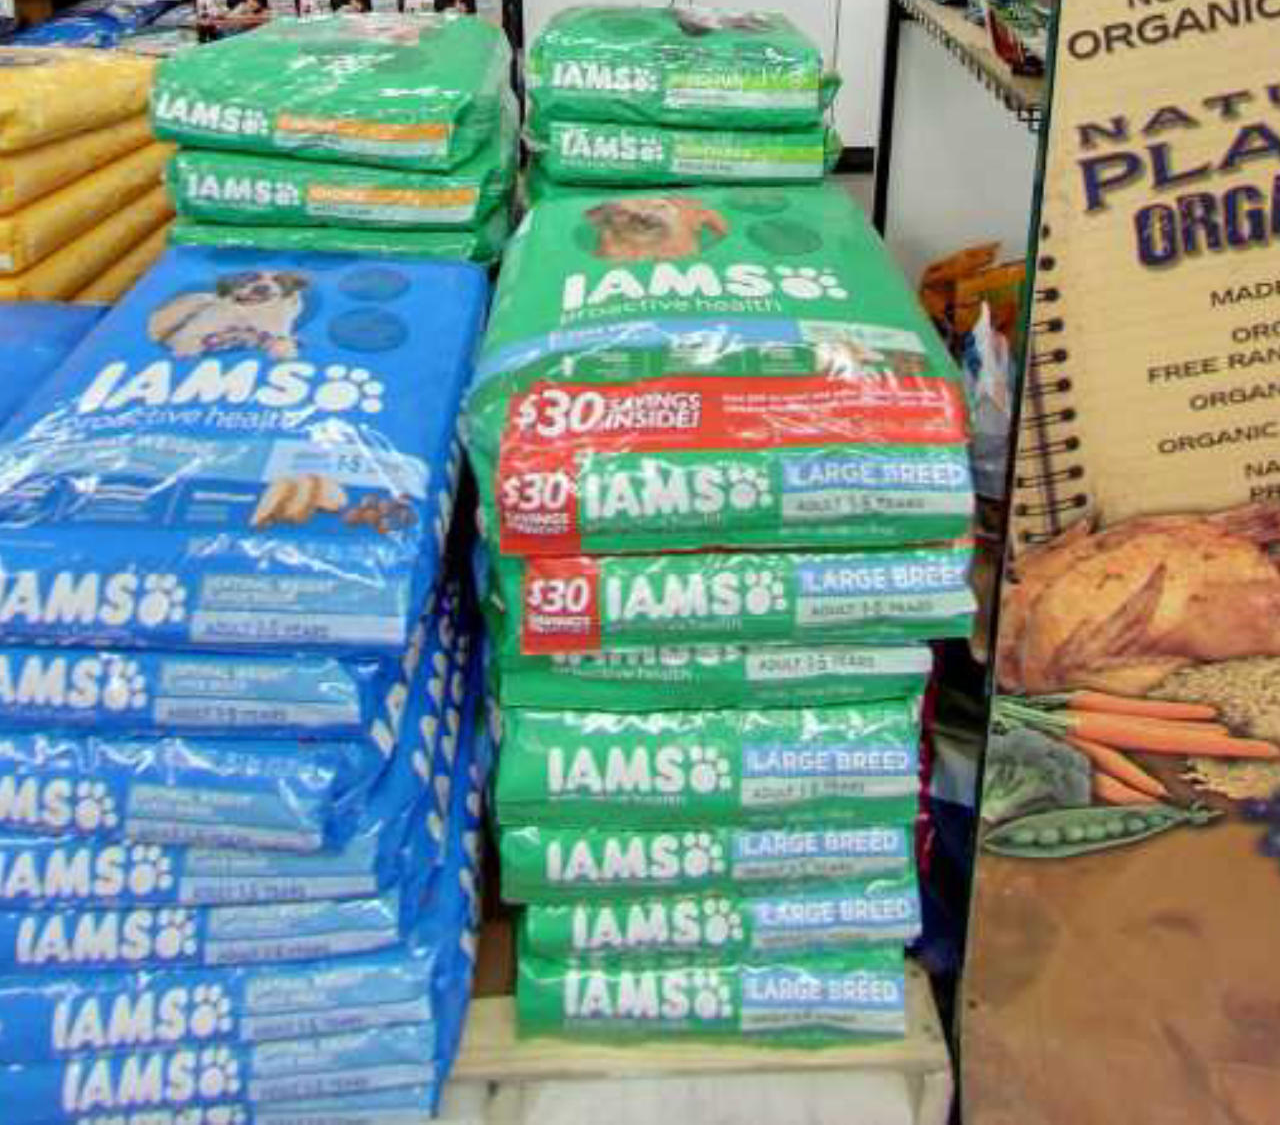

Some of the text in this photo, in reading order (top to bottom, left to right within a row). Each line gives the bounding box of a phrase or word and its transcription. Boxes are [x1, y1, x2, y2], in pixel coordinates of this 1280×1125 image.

[552, 61, 634, 90] IAMS
[154, 95, 244, 133] IAMS
[561, 129, 637, 159] IAMS
[187, 175, 274, 206] IAMS
[562, 262, 775, 311] IAMS
[695, 294, 783, 313] health
[75, 361, 316, 415] IAMS
[1147, 356, 1222, 386] FREE
[214, 406, 301, 430] health
[518, 388, 605, 438] $30
[604, 392, 701, 411] SAVINGS
[602, 409, 701, 430] INSIDE!
[1157, 418, 1280, 455] ORGANIC
[502, 473, 568, 509] $30
[584, 459, 726, 520] IAMS
[792, 463, 868, 487] LARGE
[527, 578, 590, 613] $30
[605, 572, 742, 622] IAMS
[803, 567, 887, 591] LARGE
[546, 746, 909, 795] IAMS LARGE BREED
[546, 828, 899, 882] IAMS LARGE BREED
[16, 910, 153, 964] IAMS
[572, 903, 703, 950] IAMS
[840, 899, 913, 921] BREED
[51, 987, 189, 1050] IAMS
[563, 969, 898, 1019] IAMS LARGE BREED
[62, 1050, 200, 1112] IAMS
